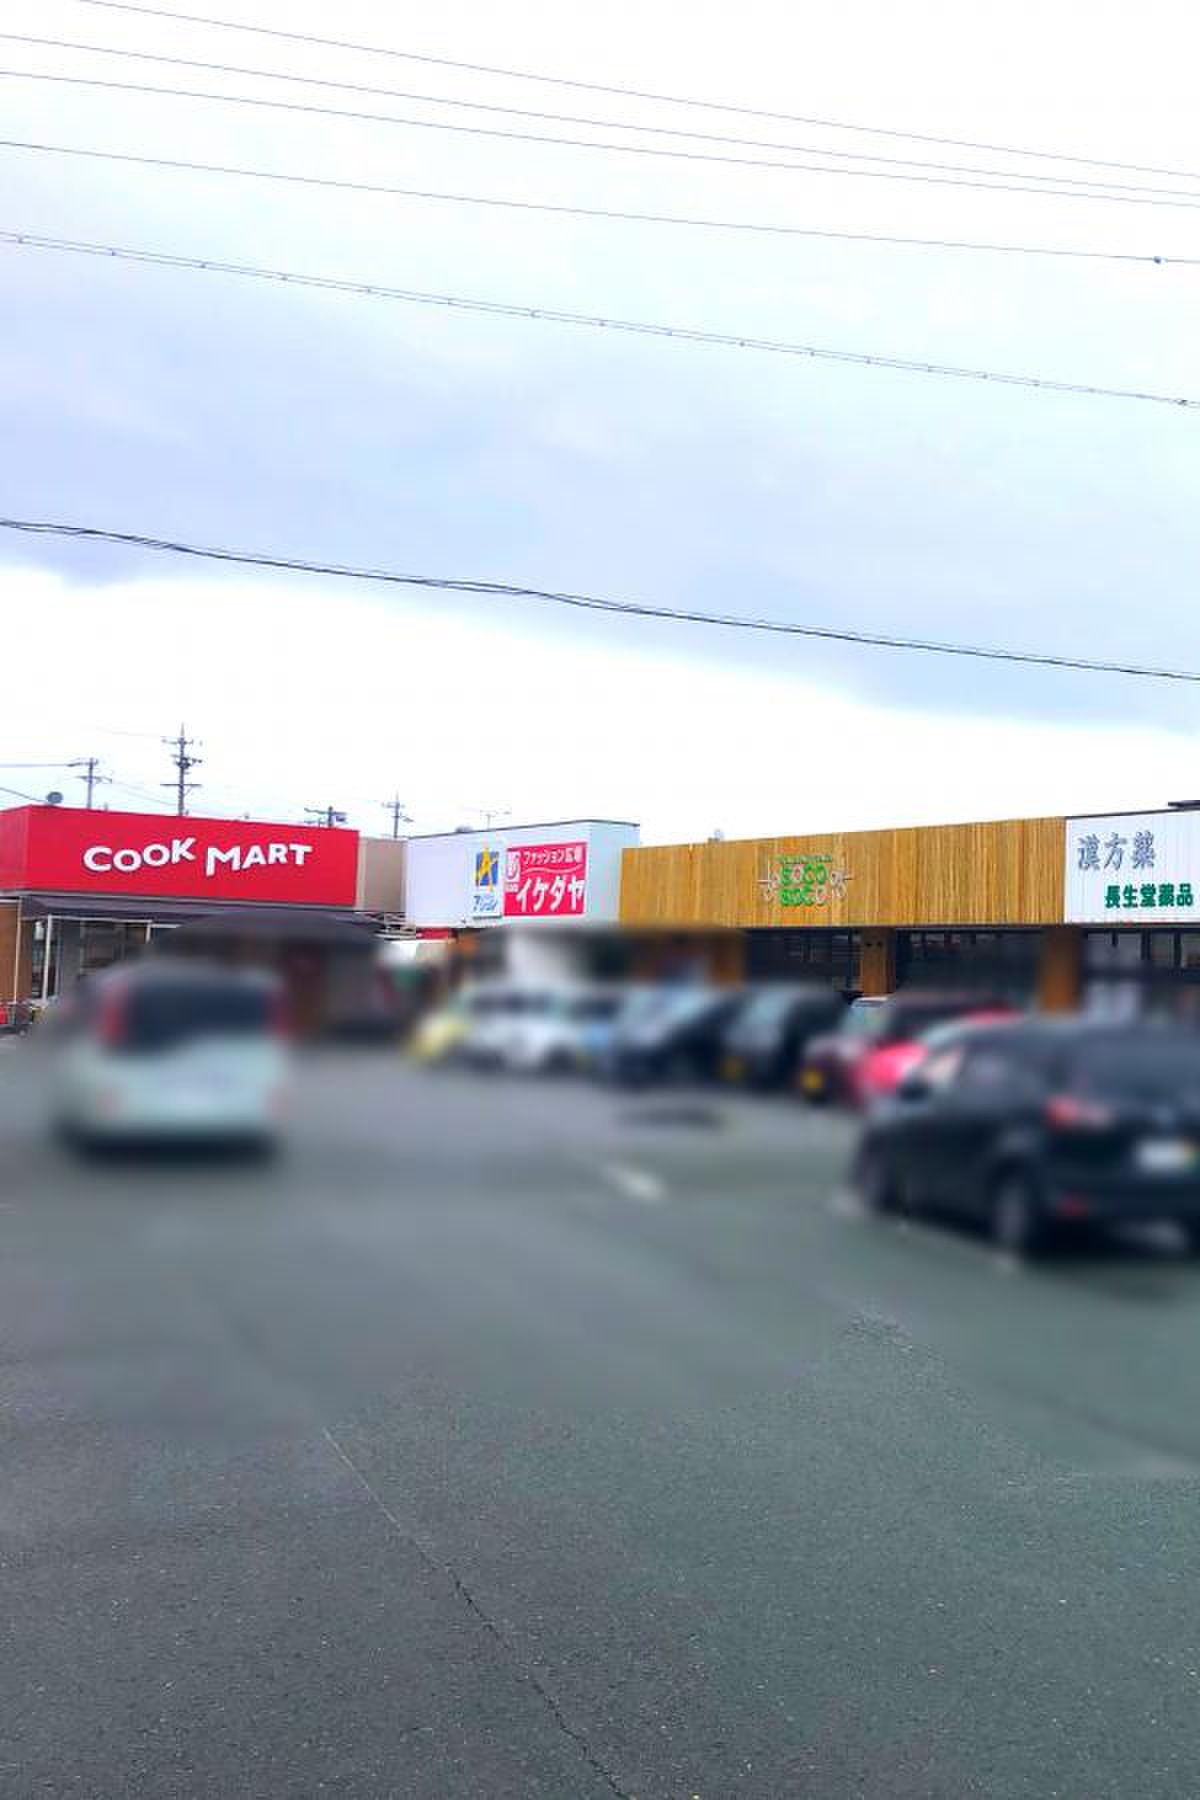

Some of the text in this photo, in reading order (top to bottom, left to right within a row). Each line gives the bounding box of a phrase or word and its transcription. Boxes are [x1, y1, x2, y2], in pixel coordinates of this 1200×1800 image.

[82, 836, 314, 877] COOK MART
[516, 875, 585, 912] イケダヤ
[1104, 883, 1194, 908] 長生堂薬品
